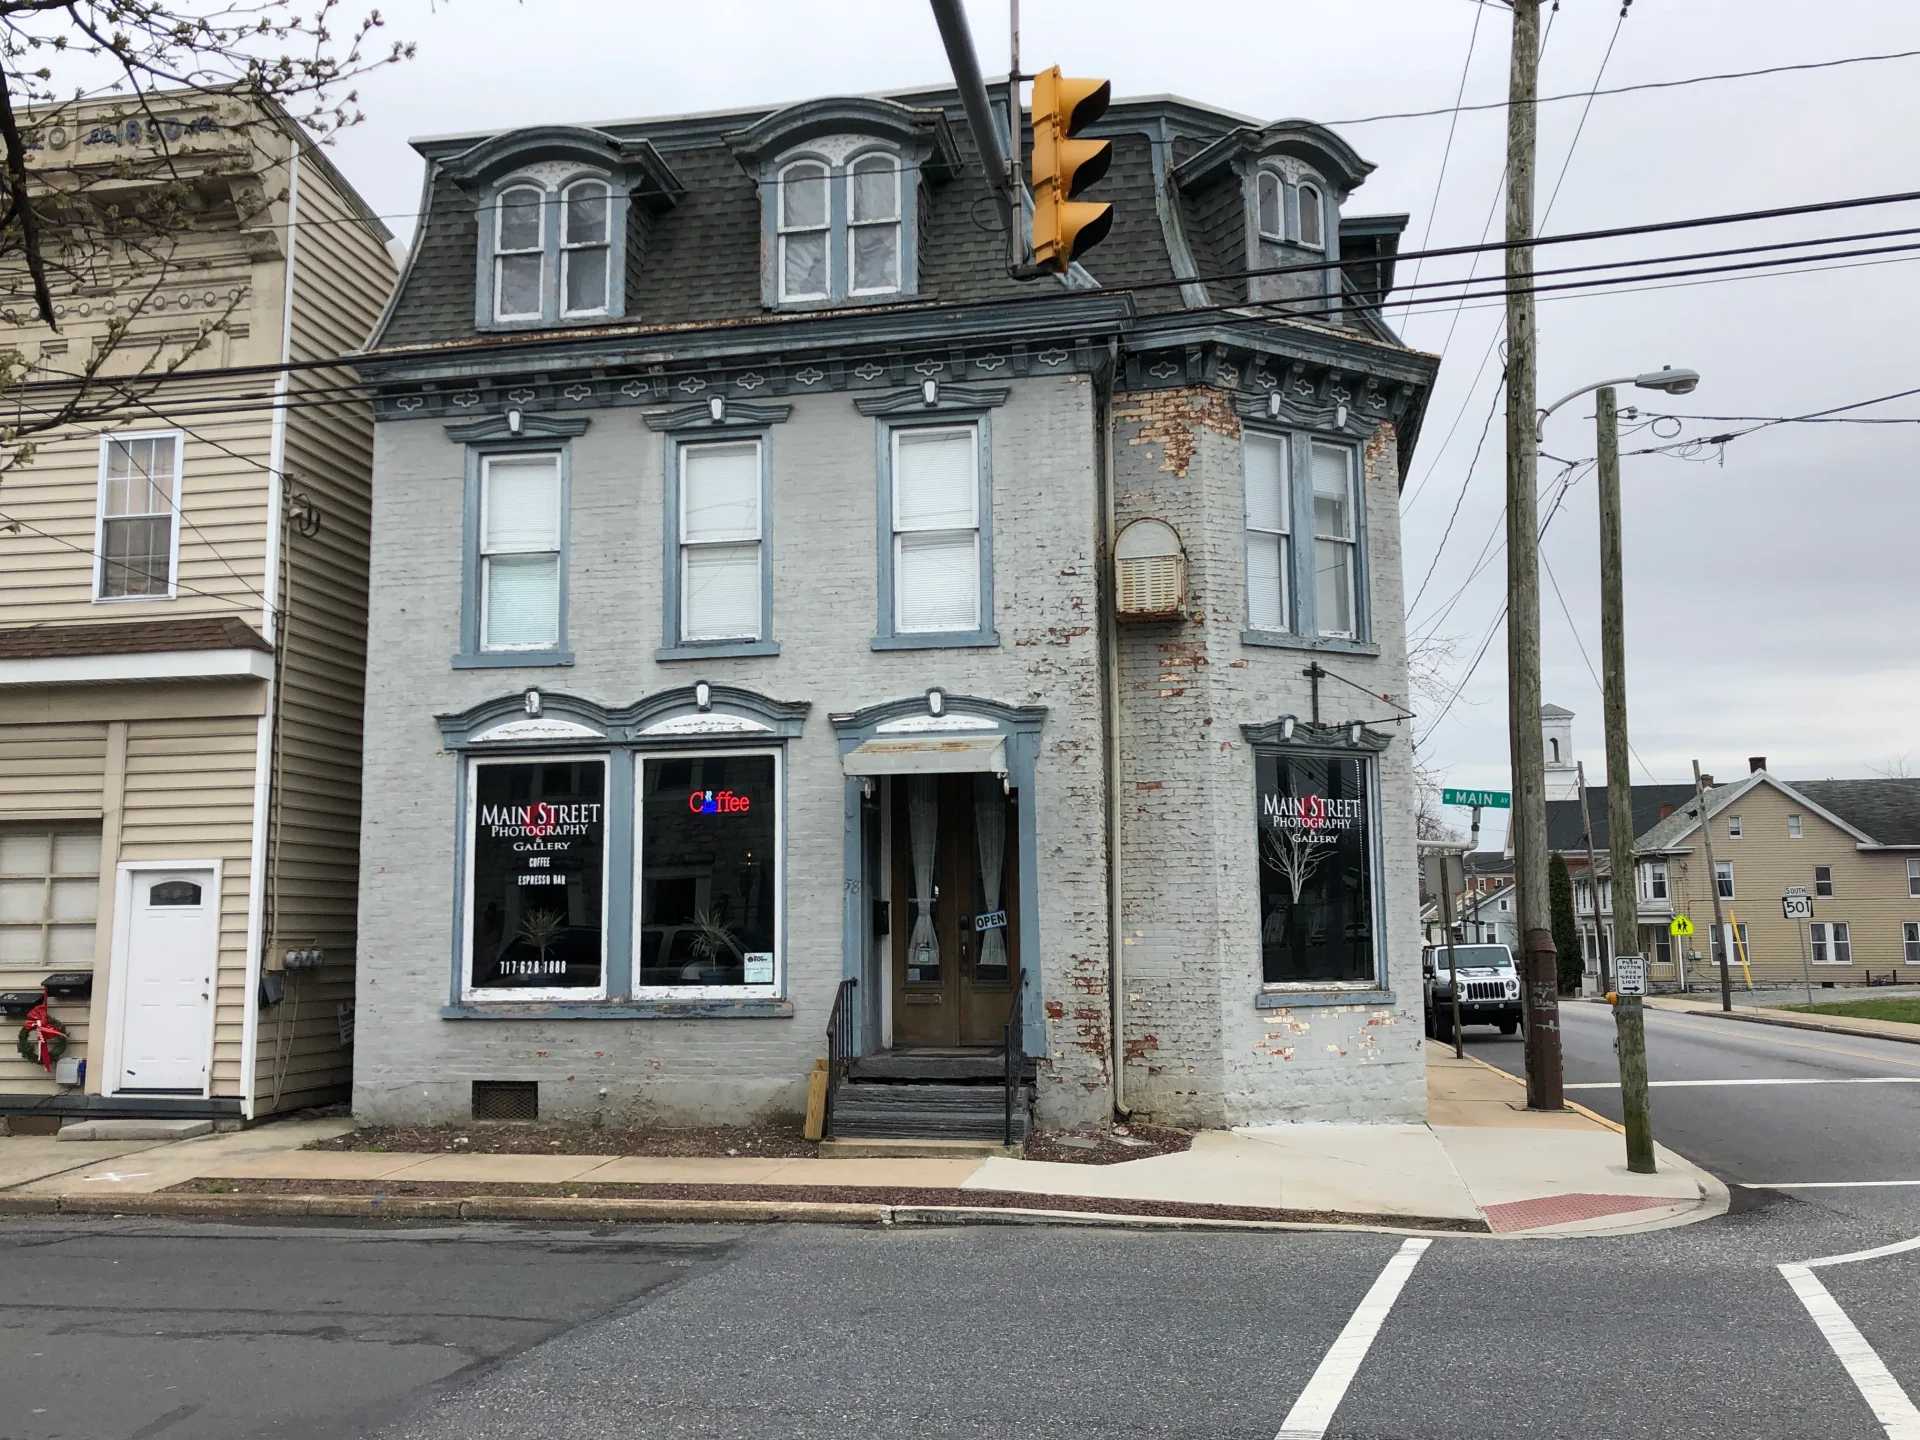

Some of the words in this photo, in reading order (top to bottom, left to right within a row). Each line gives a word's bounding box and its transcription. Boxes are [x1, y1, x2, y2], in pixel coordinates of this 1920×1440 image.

[1456, 791, 1493, 805] MAIN
[1264, 794, 1304, 815] MAIN
[1310, 795, 1360, 817] STREET
[481, 804, 531, 825] MAIN
[537, 802, 601, 824] STREET
[1273, 815, 1351, 829] PHOTOGRAPHY
[491, 824, 588, 837] PHOTOGRAPHY
[1292, 833, 1338, 843] GALLERY
[513, 841, 571, 852] GALLERY
[528, 857, 551, 868] COFFEE
[518, 875, 551, 886] ESPRESSO
[553, 874, 566, 885] BAR
[1786, 901, 1810, 913] 501
[976, 912, 1006, 929] OPEN
